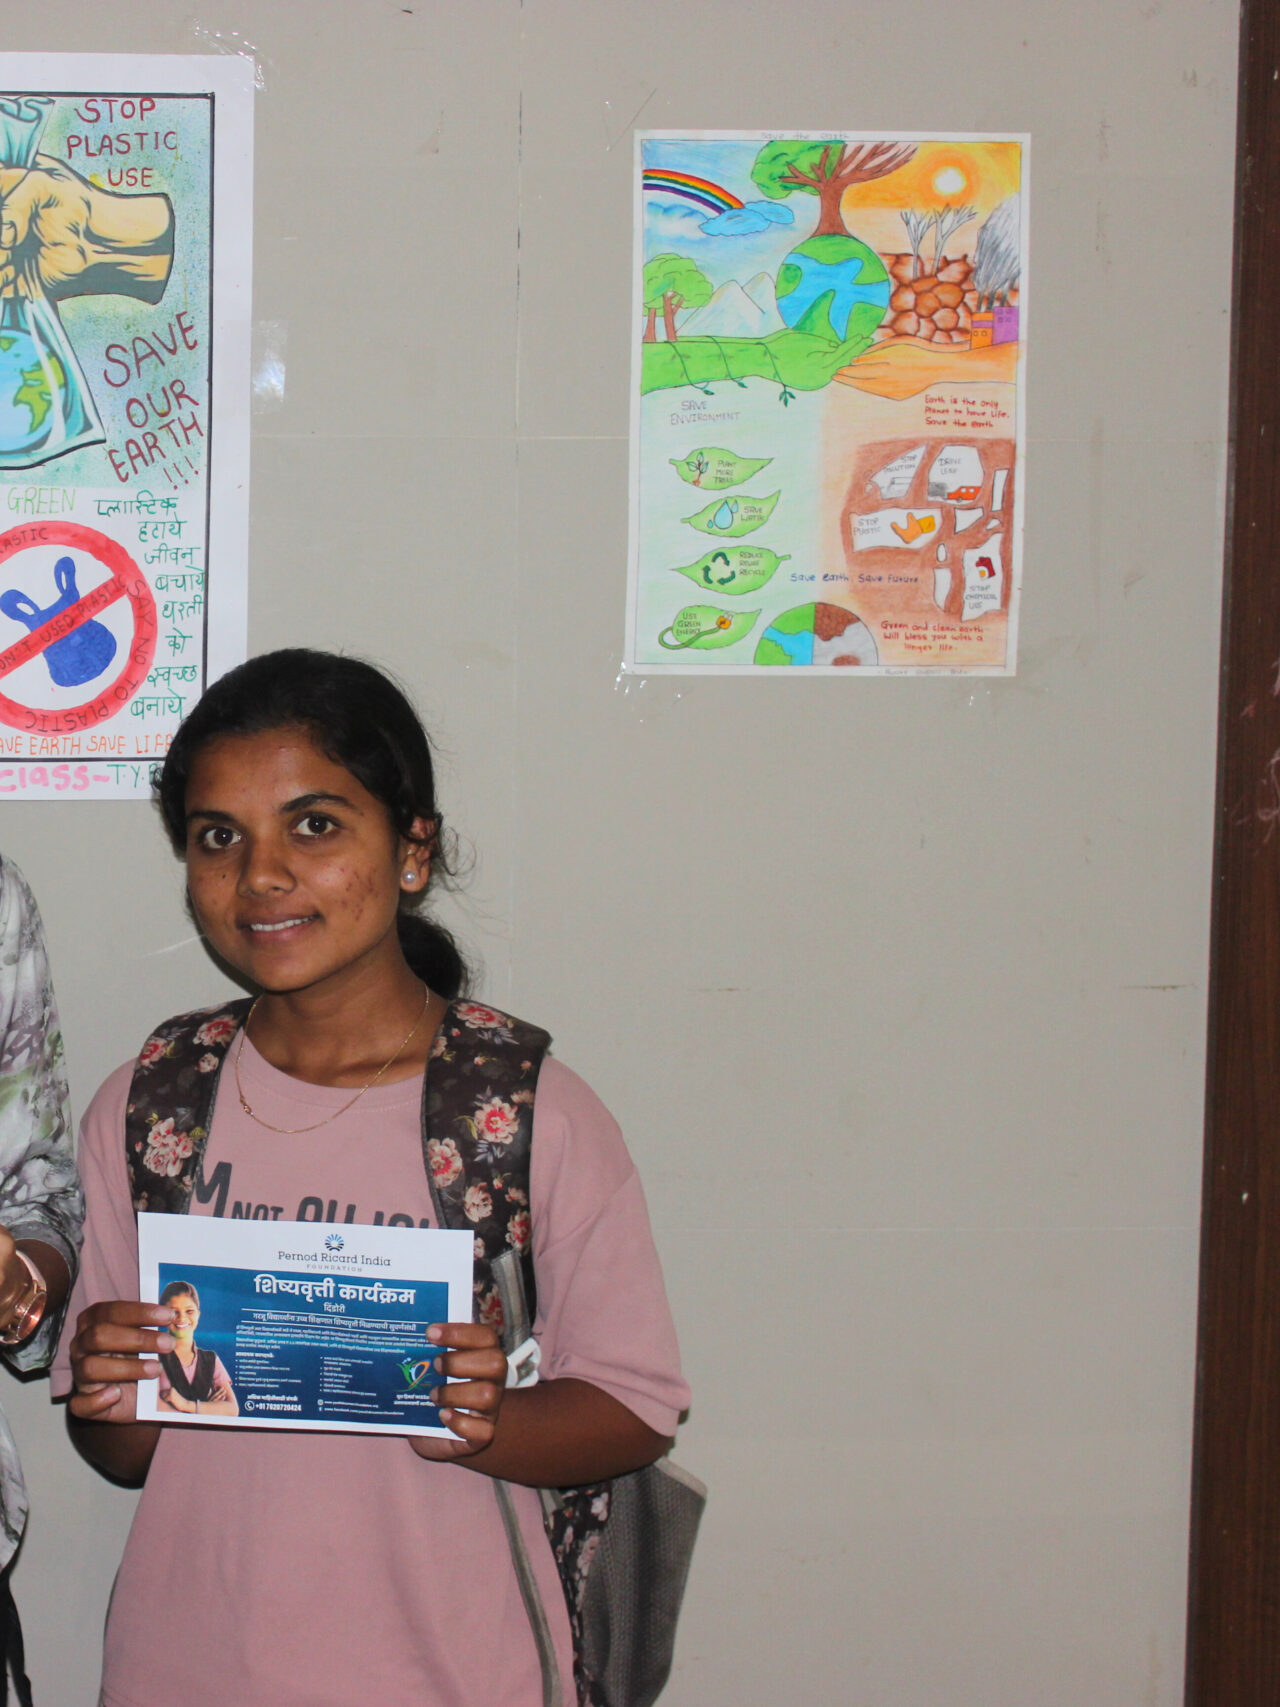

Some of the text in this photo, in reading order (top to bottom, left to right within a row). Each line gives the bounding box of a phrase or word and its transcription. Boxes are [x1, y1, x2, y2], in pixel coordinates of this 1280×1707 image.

[74, 97, 157, 123] STOP
[67, 131, 178, 159] PLASTIC
[108, 167, 154, 188] USE
[104, 311, 198, 387] SAVE
[126, 379, 200, 428] OUR
[681, 400, 707, 410] SAVE
[108, 411, 204, 482] EARTH
[8, 486, 76, 515] GREEN
[144, 543, 200, 565] जीवन
[39, 613, 75, 643] USED
[165, 627, 193, 657] को
[25, 579, 154, 732] SAY NO TO PLASTIC
[30, 737, 80, 755] EARTH
[86, 736, 126, 754] SAVE
[136, 734, 173, 753] LIFE
[278, 1251, 391, 1266] Pernod Ricard India
[306, 1264, 363, 1273] FOUNDATION
[254, 1273, 416, 1305] शिष्यवृत्ती कार्यक्रम
[323, 1302, 345, 1313] दिंडोरी
